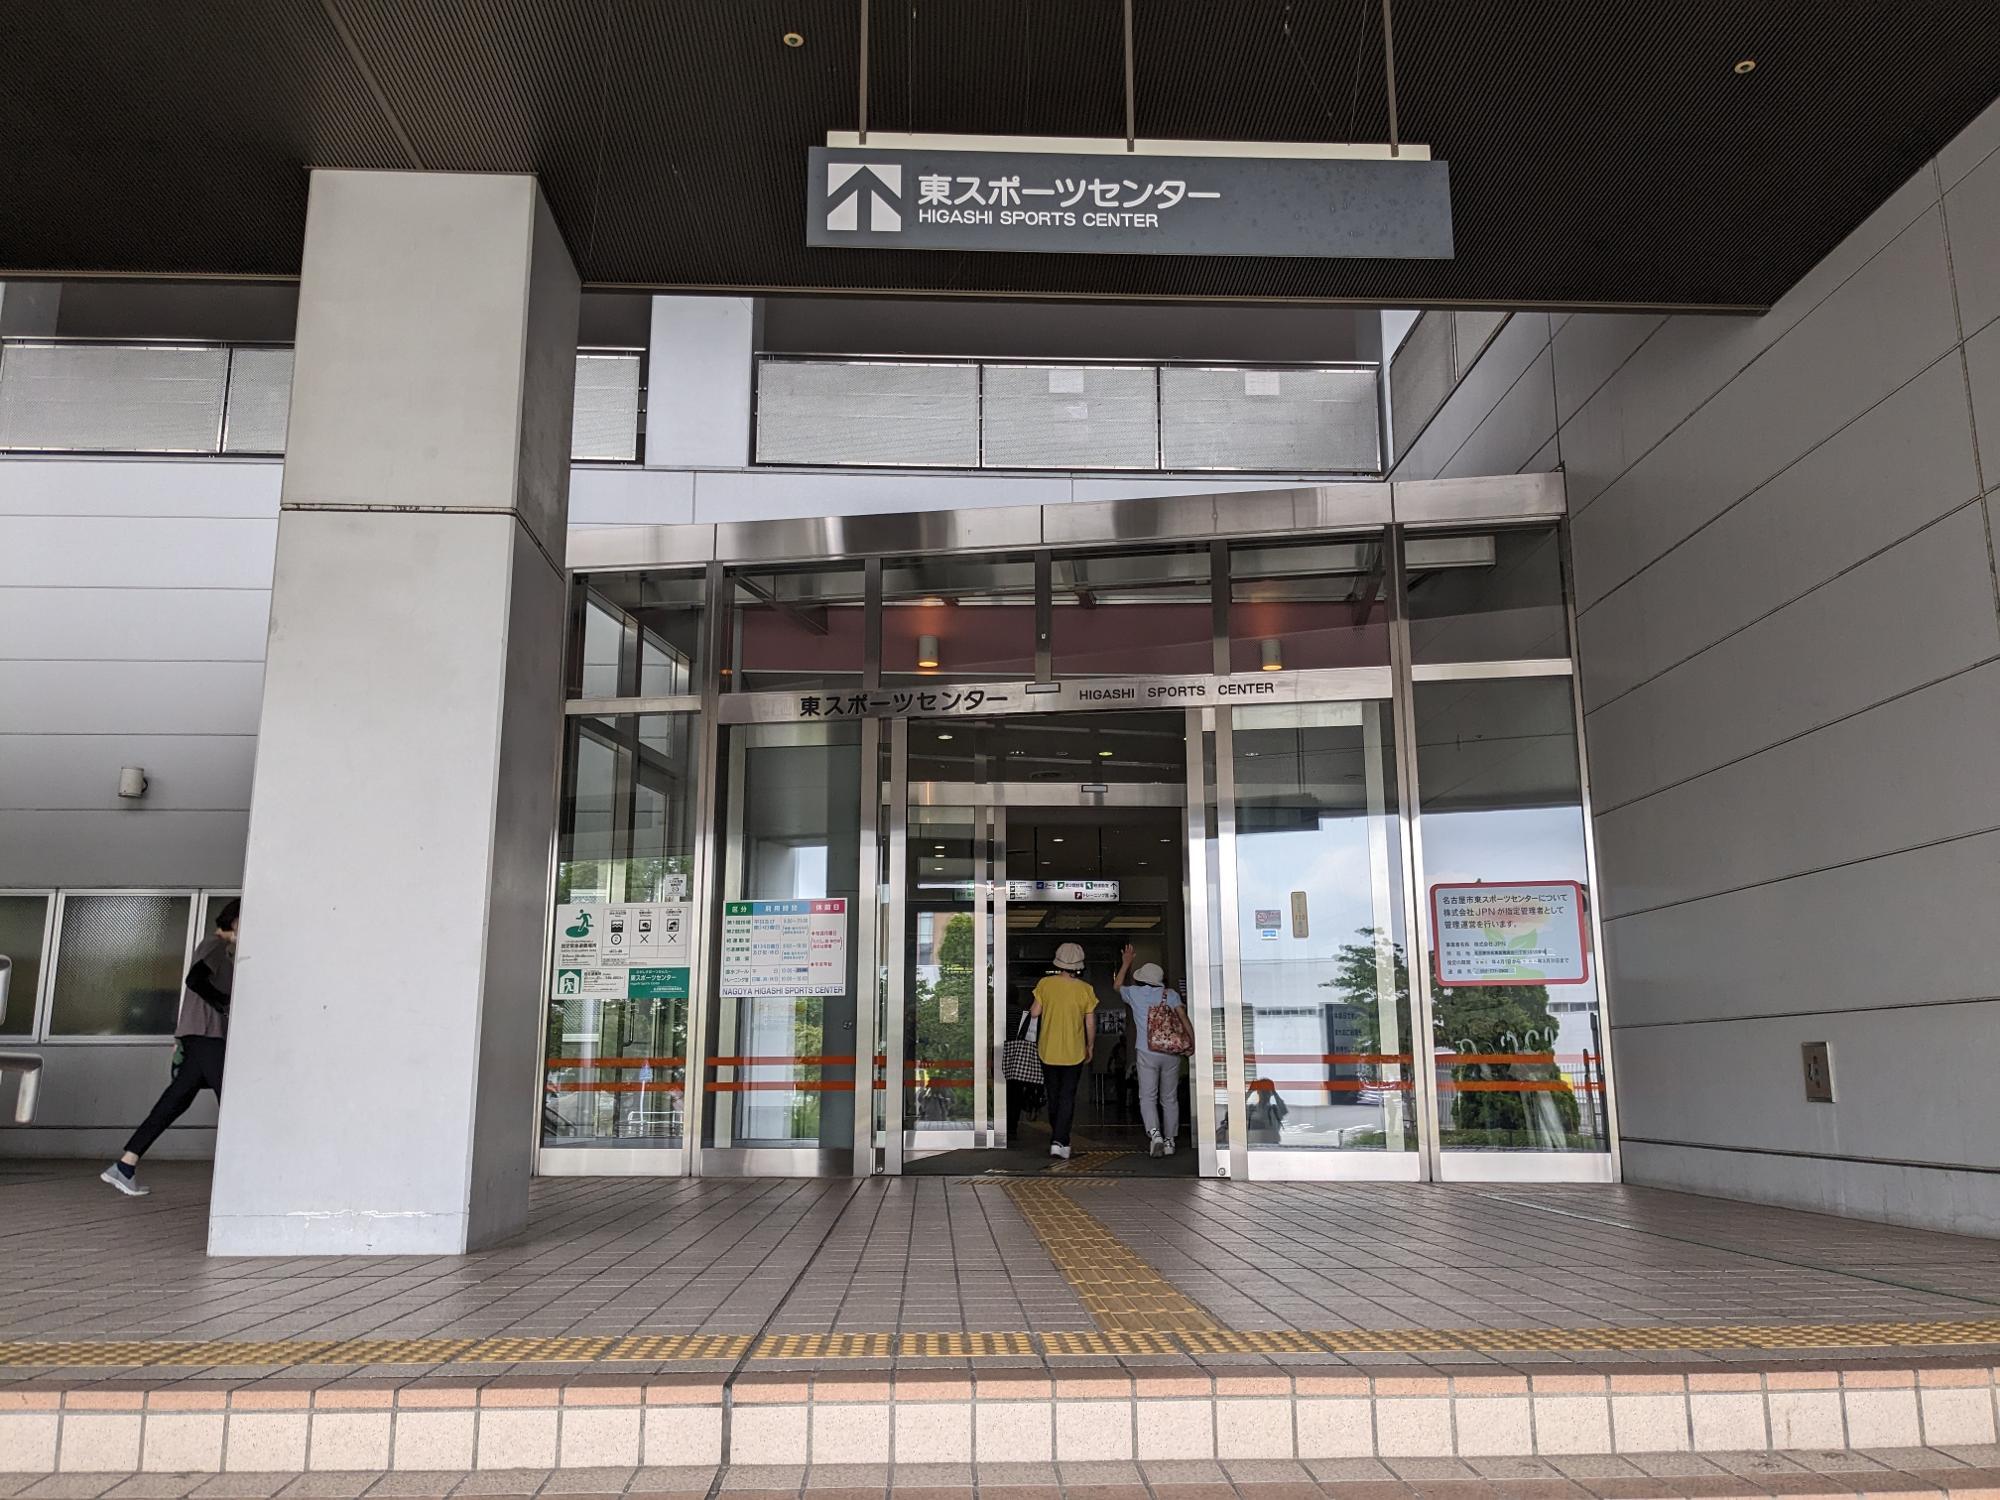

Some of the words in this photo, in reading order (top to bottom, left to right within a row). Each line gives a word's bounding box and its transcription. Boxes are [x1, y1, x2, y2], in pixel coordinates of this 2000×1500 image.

[918, 173, 1221, 210] 東スポーツセンター
[919, 209, 993, 225] HIGASHI
[1000, 211, 1076, 227] SPORTS
[1082, 212, 1159, 228] CENTER
[1079, 688, 1135, 701] HIGASHI
[1147, 685, 1206, 698] SPORTS
[1217, 682, 1275, 695] CENTER
[800, 690, 1008, 717] 東スポーツセンター
[1442, 894, 1568, 905] 名古屋市東スポーツセンターについて
[722, 987, 753, 995] NAGOYA
[755, 986, 783, 995] HIGASHI
[784, 986, 813, 994] SPORTS
[815, 985, 843, 993] CENTER
